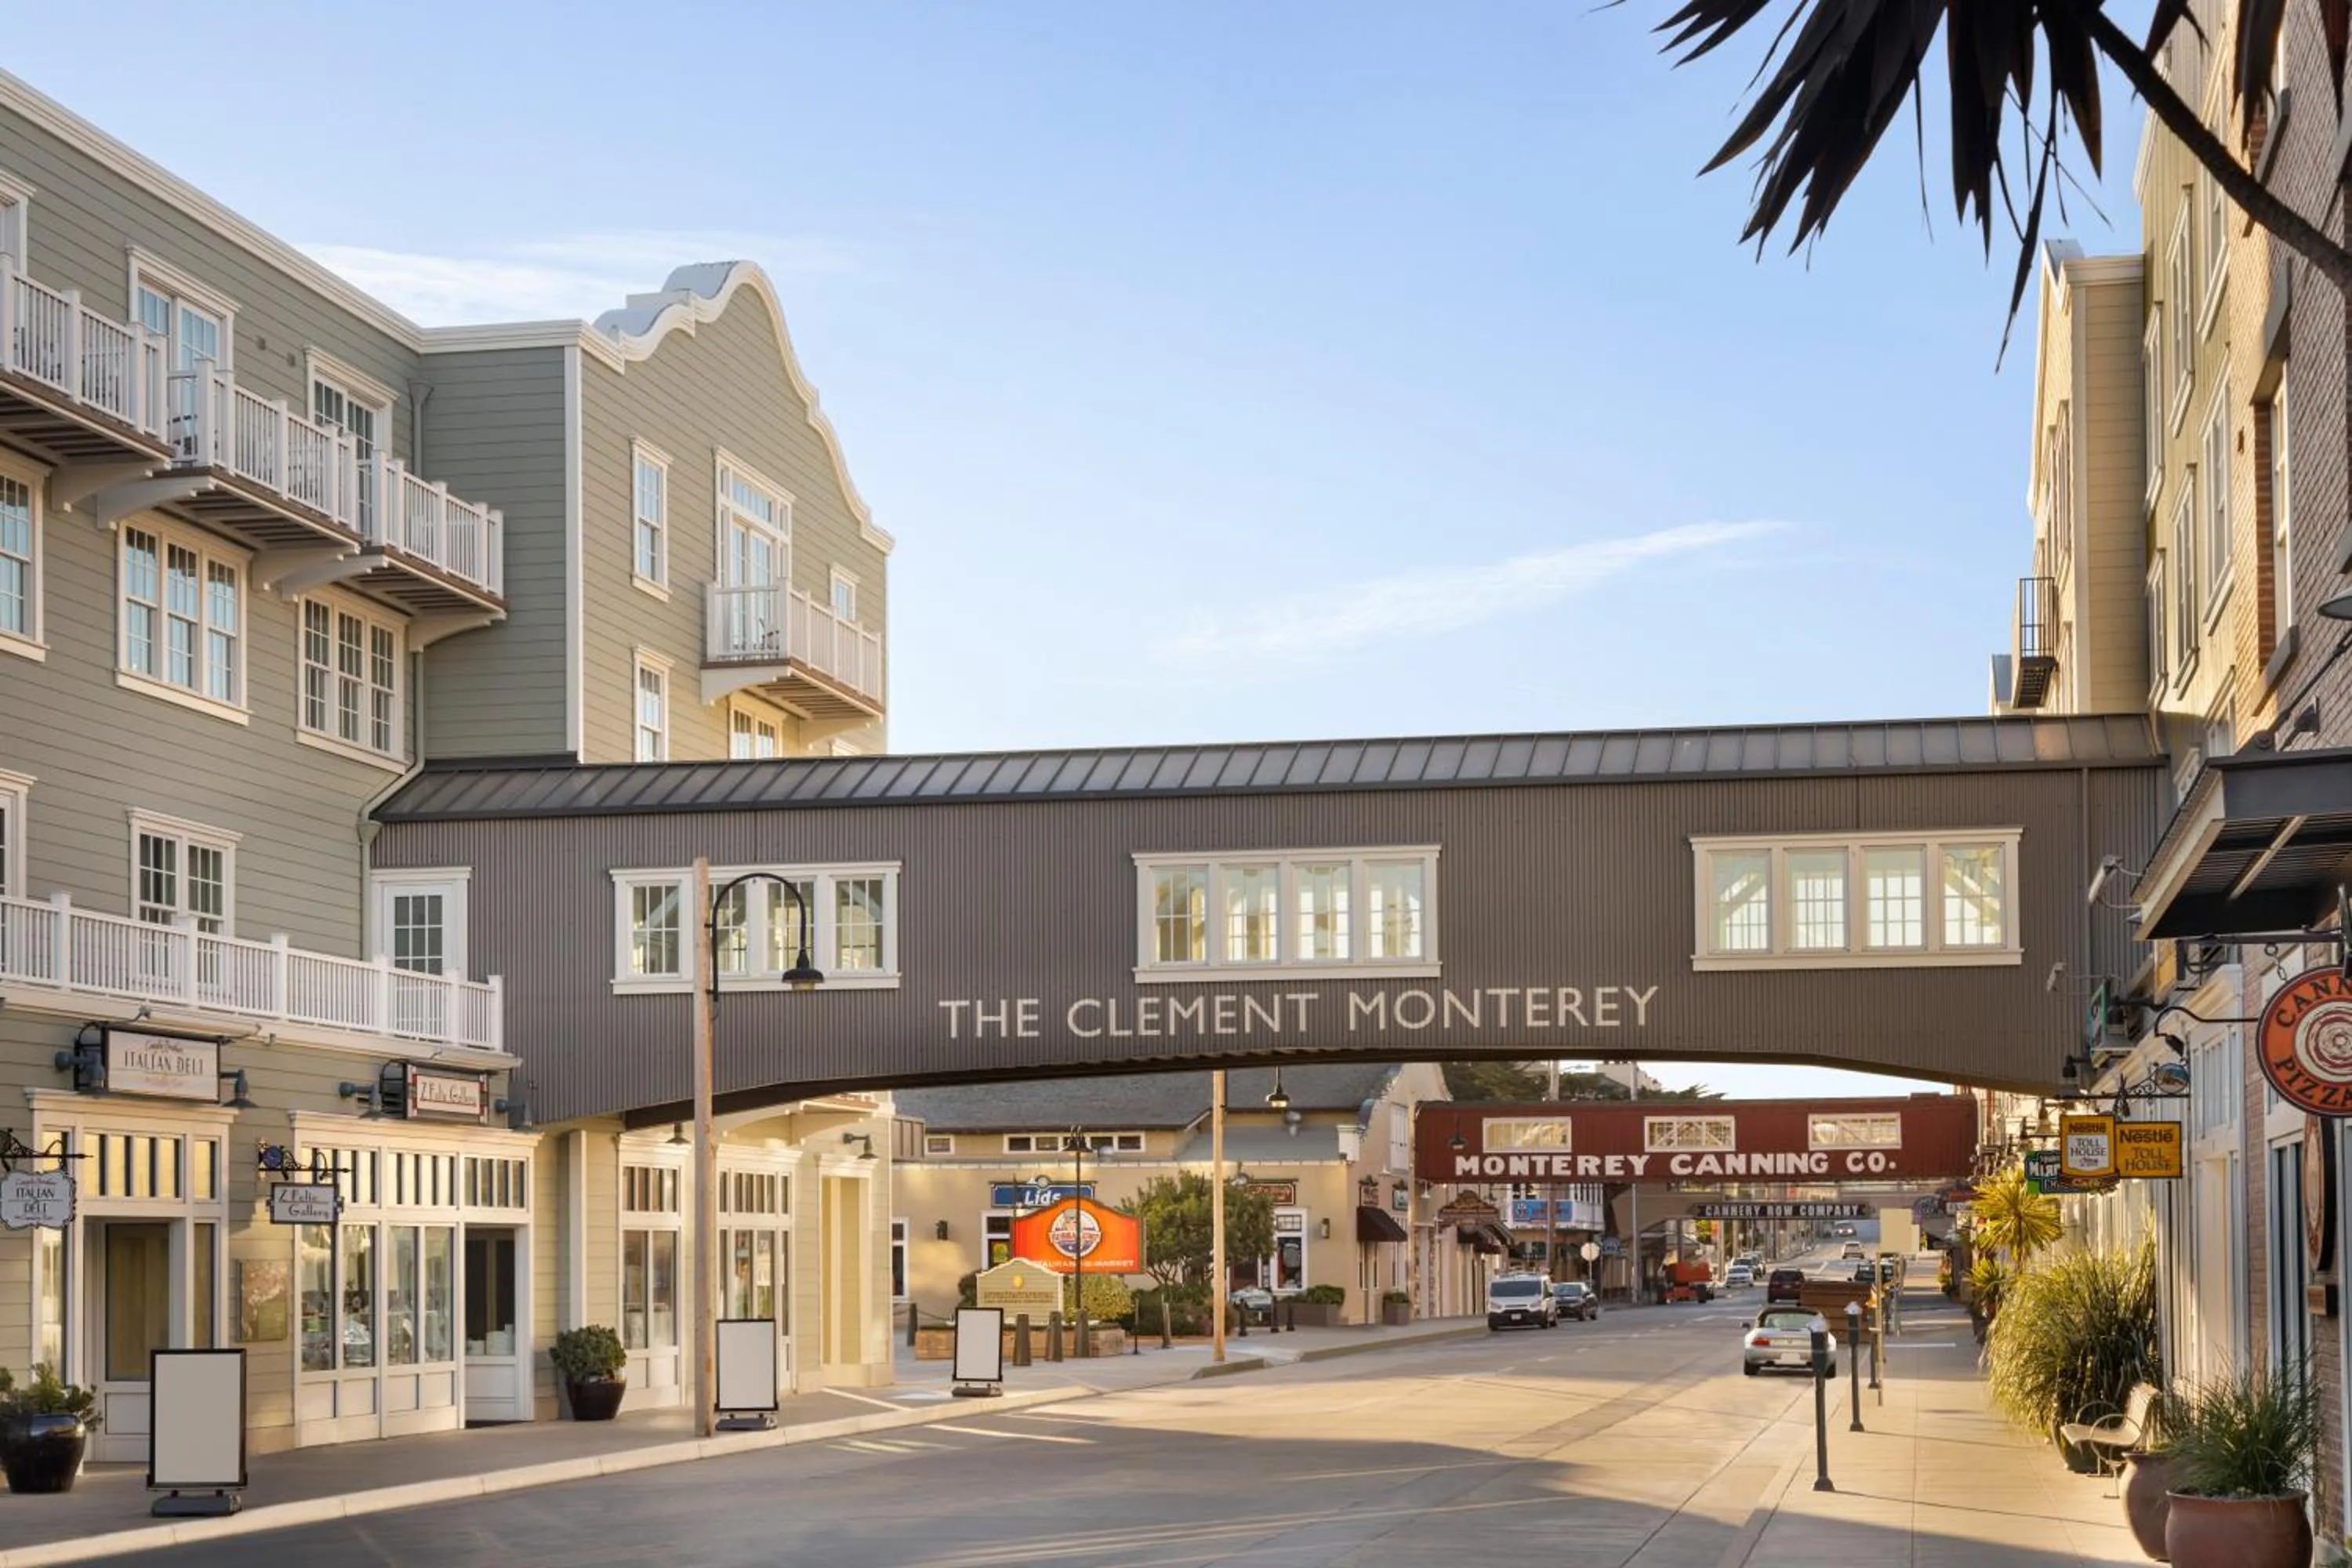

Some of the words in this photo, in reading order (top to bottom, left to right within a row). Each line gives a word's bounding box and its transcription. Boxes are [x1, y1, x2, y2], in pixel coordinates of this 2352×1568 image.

[938, 997, 1040, 1039] THE
[1067, 993, 1319, 1037] CLEMENT
[1348, 985, 1659, 1032] MONTEREY
[124, 1050, 172, 1072] ITALIAN
[176, 1056, 204, 1076] DELI
[2077, 1138, 2100, 1147] TOLL
[2070, 1147, 2107, 1157] HOUSE
[2132, 1147, 2164, 1160] TOLL
[1455, 1155, 1650, 1176] MONTEREY
[1670, 1152, 1829, 1175] CANNING
[1846, 1151, 1897, 1173] CO.
[2125, 1159, 2171, 1171] HOUSE
[16, 1187, 55, 1199] ITALIAN
[1024, 1191, 1062, 1205] Lids
[24, 1202, 46, 1213] DELI
[1705, 1204, 1761, 1217] CANNERY
[1766, 1204, 1793, 1216] ROW
[1799, 1204, 1859, 1216] COMPANY
